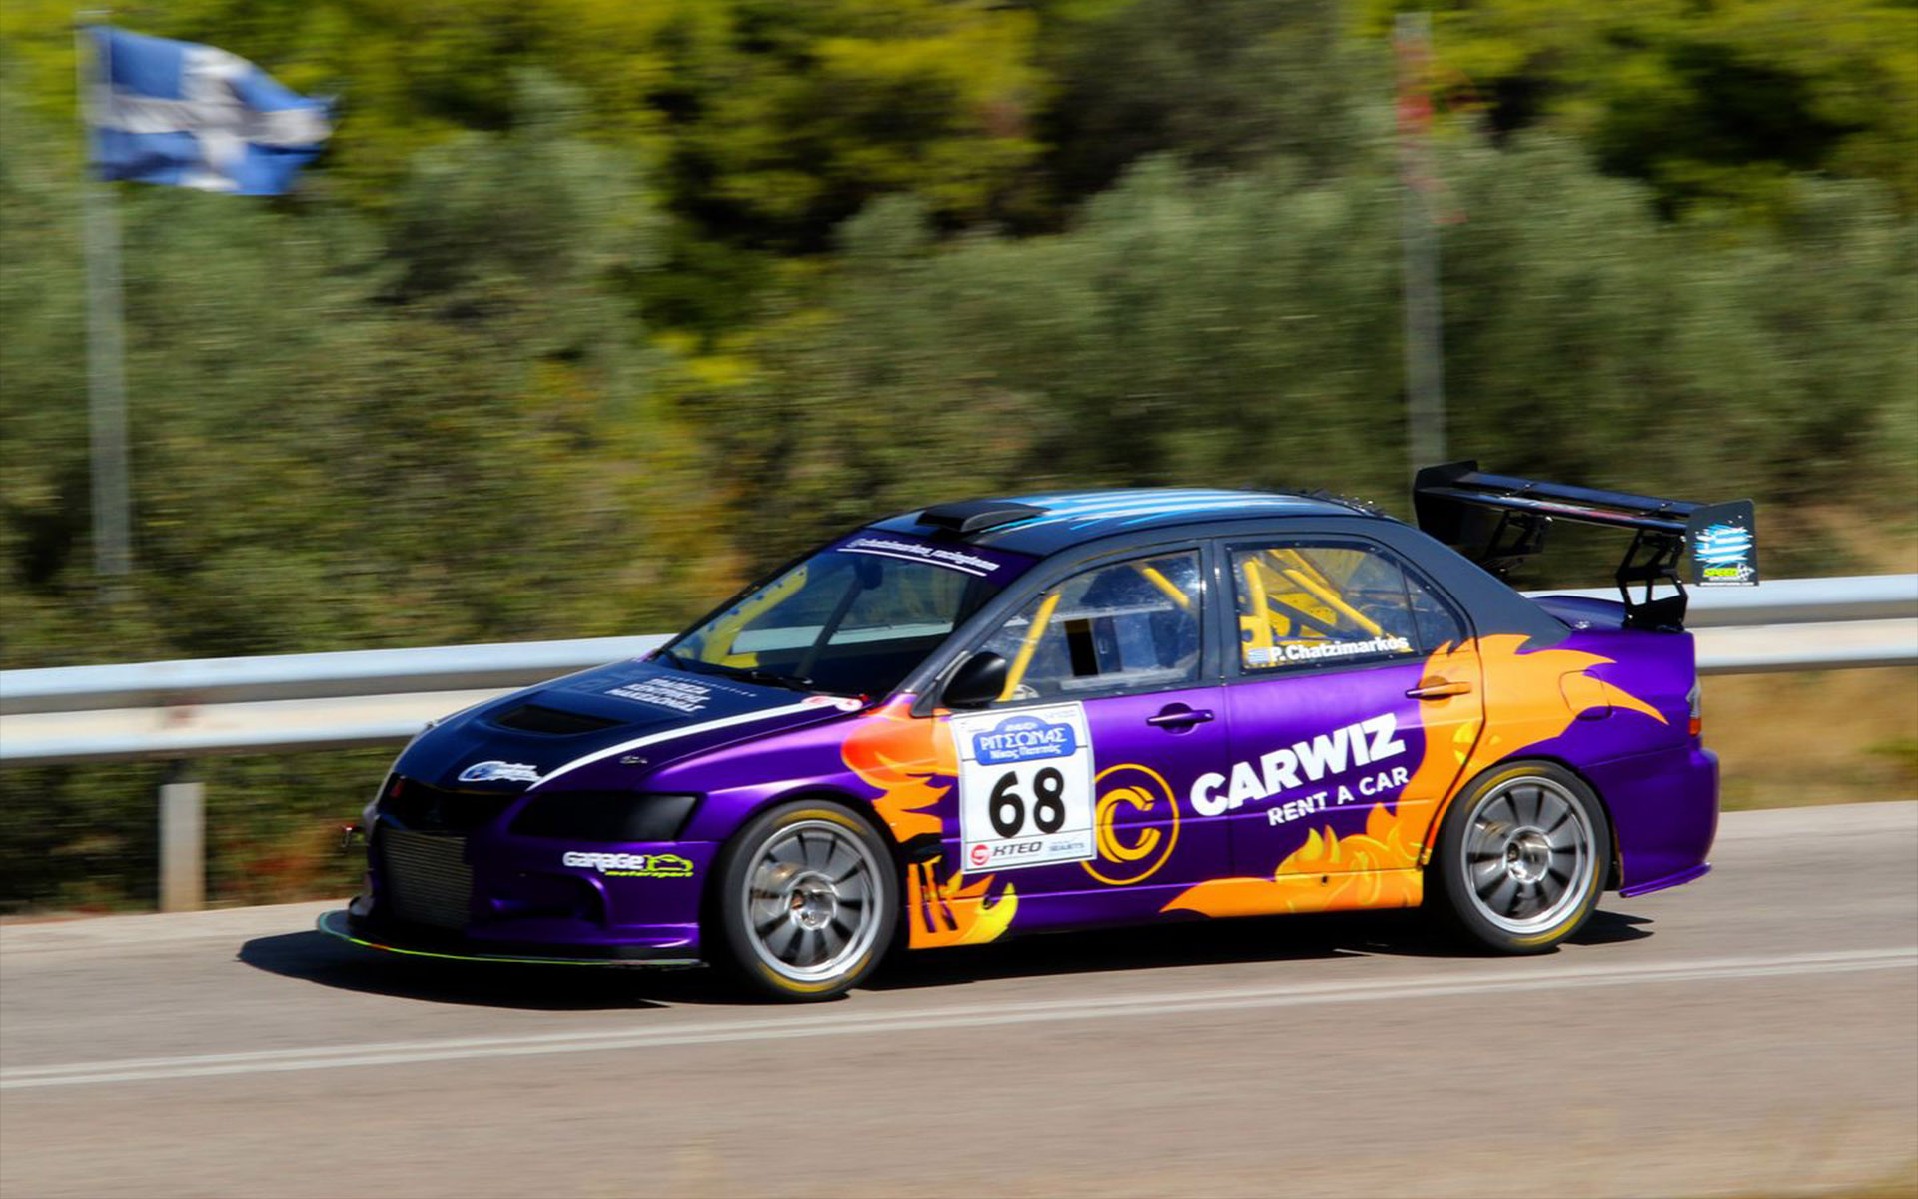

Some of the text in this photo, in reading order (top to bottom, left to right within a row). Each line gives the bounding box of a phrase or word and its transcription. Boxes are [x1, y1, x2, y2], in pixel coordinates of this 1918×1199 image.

[1190, 712, 1407, 817] CARWIZ
[1267, 766, 1409, 826] RENT A CAR
[988, 766, 1066, 839] 68
